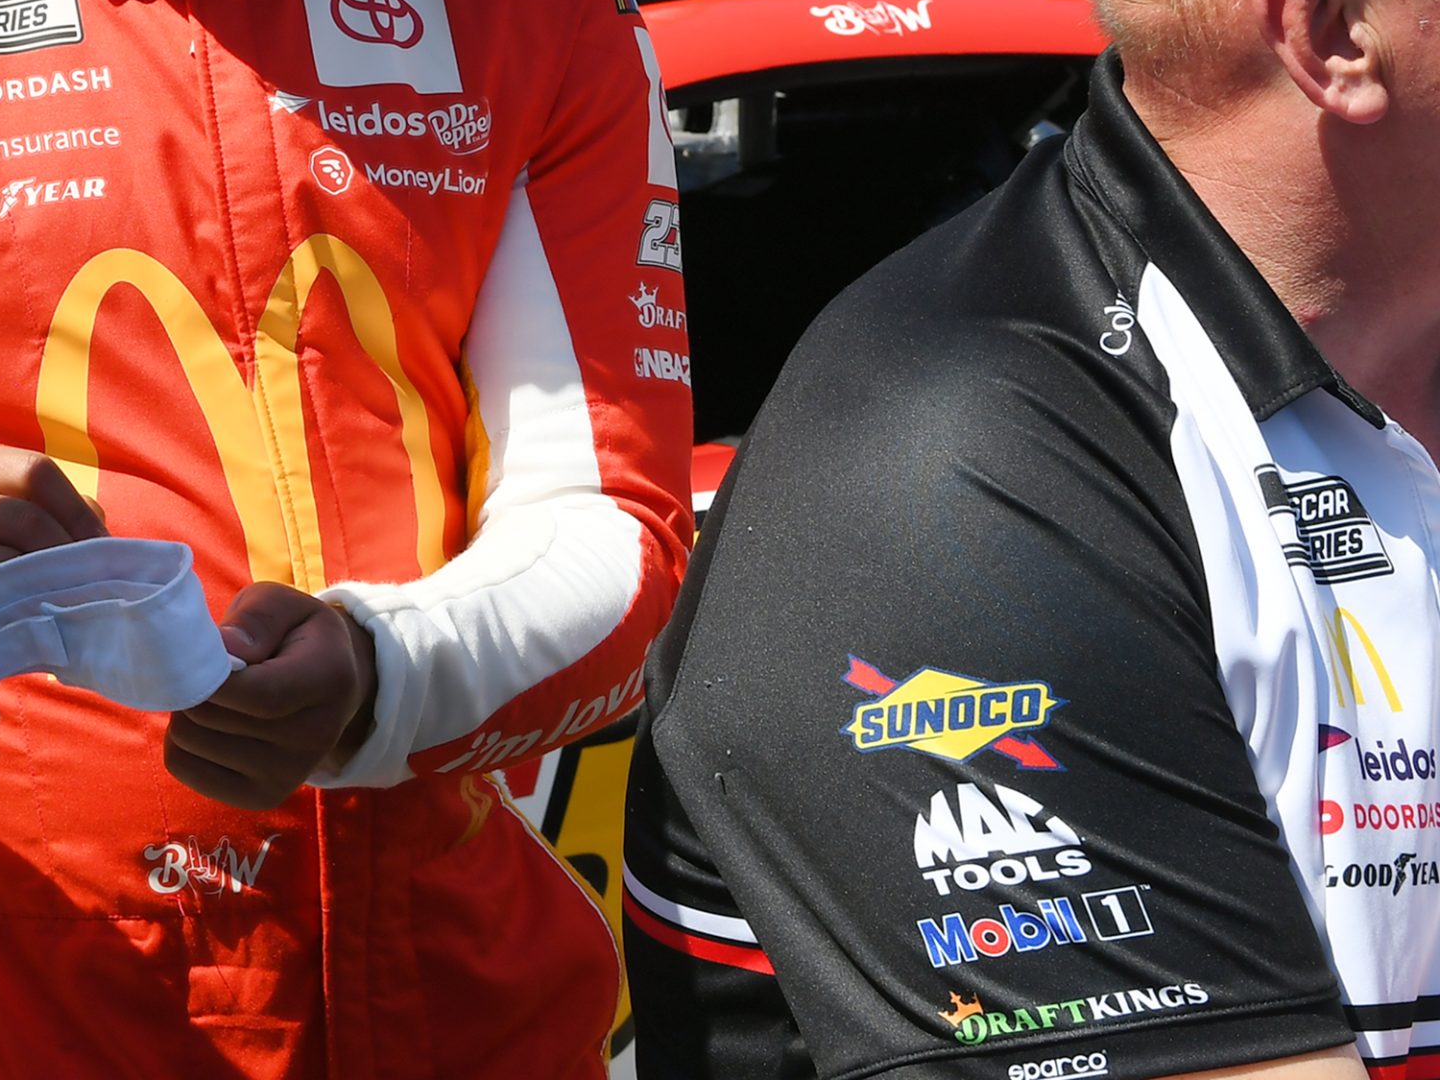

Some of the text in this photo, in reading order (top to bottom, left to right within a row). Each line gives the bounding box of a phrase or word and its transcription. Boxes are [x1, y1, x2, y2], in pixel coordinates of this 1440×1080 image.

[317, 100, 427, 137] leidos
[449, 103, 479, 128] Dr
[364, 162, 486, 195] MoneyLion
[1309, 527, 1364, 561] RIES
[859, 687, 1043, 744] SUNOCO
[913, 783, 1084, 869] MAC
[923, 848, 1093, 895] TOOLS
[917, 898, 1087, 969] Mobil
[955, 982, 1211, 1045] DRAFTKINGS
[1008, 1052, 1108, 1080] sparco
